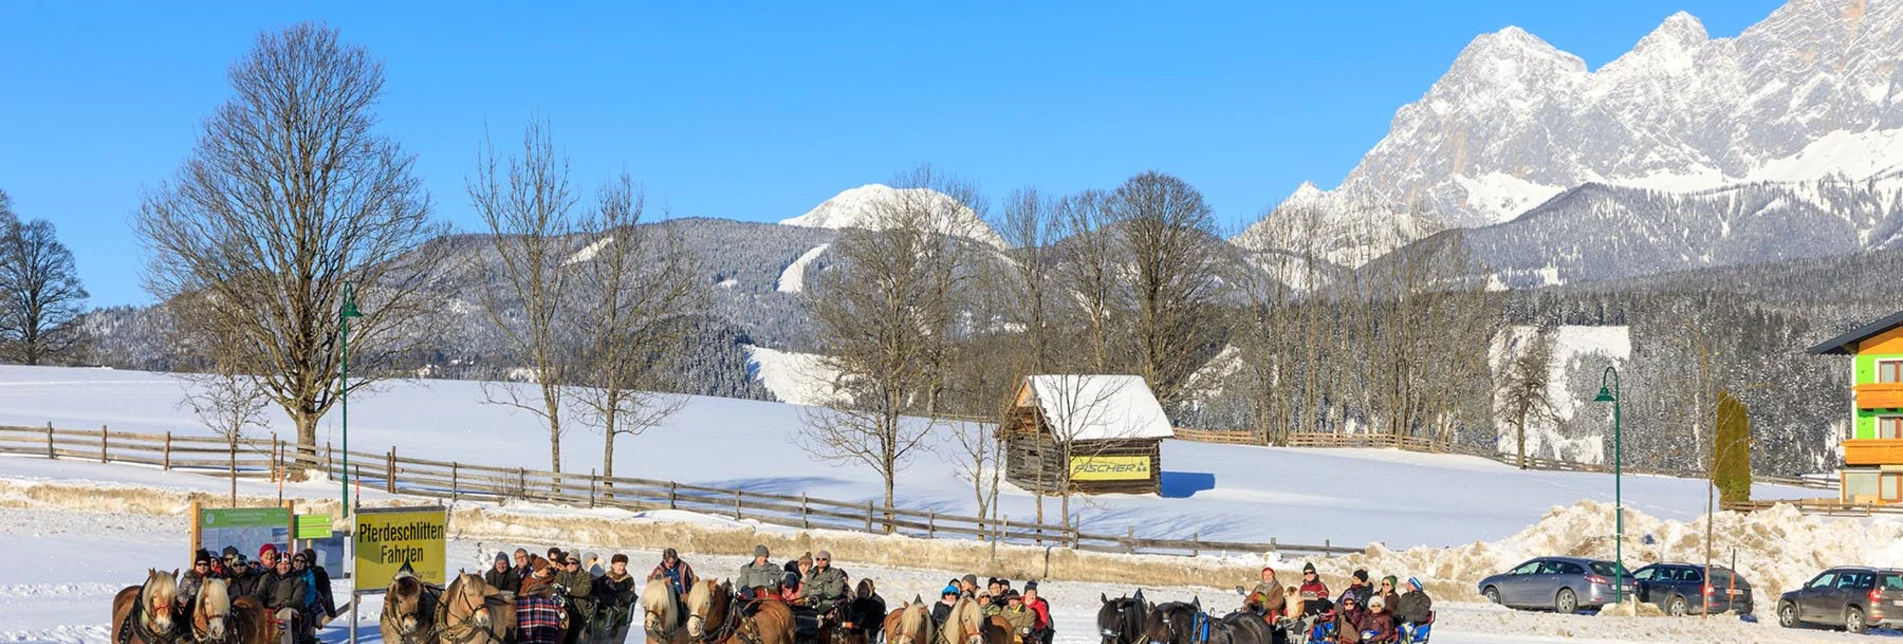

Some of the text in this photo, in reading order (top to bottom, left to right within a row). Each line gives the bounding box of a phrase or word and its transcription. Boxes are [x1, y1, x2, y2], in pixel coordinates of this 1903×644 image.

[1074, 464, 1136, 473] FISCHER
[359, 522, 444, 543] Pferdeschlitten
[380, 544, 424, 564] Fahrten
